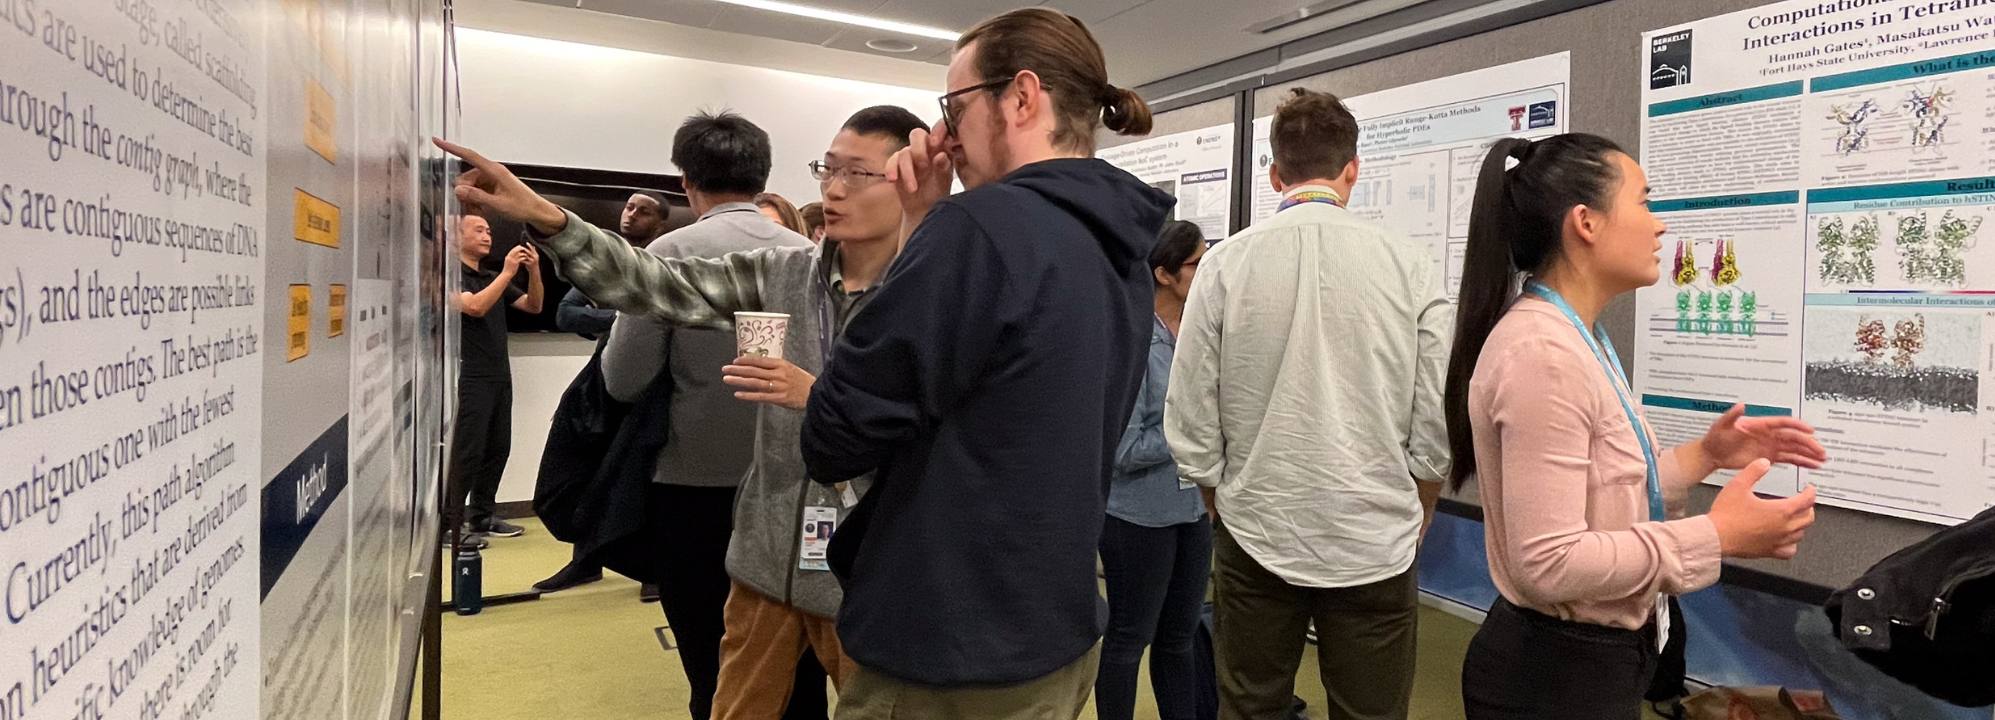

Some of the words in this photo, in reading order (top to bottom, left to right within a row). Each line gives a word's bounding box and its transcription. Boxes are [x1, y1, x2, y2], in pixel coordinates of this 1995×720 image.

[1653, 33, 1690, 46] BERKELEY
[1742, 19, 1865, 51] Interactions
[1871, 11, 1892, 27] in
[1899, 0, 1995, 21] Tetram
[1748, 0, 1893, 30] Computatio
[1768, 45, 1821, 65] Hannah
[1877, 22, 1961, 46] Masakatsu
[1965, 15, 1995, 29] Wa
[164, 16, 203, 71] called
[1653, 45, 1668, 54] LAB
[1787, 60, 1814, 74] Hays
[1816, 54, 1846, 69] State
[1848, 43, 1915, 63] University,
[1913, 59, 1950, 75] What
[1956, 58, 1971, 69] is
[43, 9, 76, 61] are
[82, 35, 127, 91] used
[132, 57, 148, 101] to
[152, 67, 217, 139] determine
[218, 108, 235, 148] the
[236, 117, 254, 158] best
[1700, 93, 1743, 107] Abstract
[1449, 105, 1482, 118] Methods
[82, 104, 111, 160] the
[116, 133, 163, 192] contig
[165, 151, 202, 200] graph,
[205, 160, 237, 202] where
[238, 172, 252, 207] the
[20, 188, 57, 232] are
[63, 192, 161, 258] contiguous
[164, 218, 223, 262] sequences
[225, 222, 237, 254] of
[236, 222, 259, 258] DNA
[1684, 196, 1752, 209] Introduction
[1853, 200, 1889, 210] Residue
[1890, 196, 1950, 208] Contribution
[1952, 196, 1963, 205] to
[39, 268, 80, 325] and
[87, 269, 115, 318] the
[120, 271, 165, 331] edges
[168, 283, 188, 313] are
[191, 273, 234, 325] possible
[234, 274, 256, 307] links
[1857, 295, 1923, 305] Intermolecular
[1926, 296, 1985, 307] Interactions
[31, 360, 88, 420] those
[94, 346, 157, 402] contigs.
[161, 338, 185, 380] The
[188, 334, 211, 372] best
[213, 328, 234, 378] path
[236, 327, 244, 359] is
[245, 324, 258, 355] the
[114, 428, 144, 469] one
[147, 402, 178, 454] with
[180, 395, 200, 435] the
[202, 384, 235, 426] fewest
[1691, 400, 1731, 412] Metho
[296, 450, 328, 526] Method
[6, 511, 117, 625] Currently,
[122, 488, 149, 540] this
[152, 464, 182, 534] path
[185, 437, 236, 501] algorithm
[31, 584, 127, 706] heuristics
[131, 549, 159, 606] that
[162, 536, 182, 577] are
[184, 490, 224, 555] derived
[226, 483, 248, 520] from
[72, 682, 103, 720] fic
[108, 597, 184, 707] knowledge
[187, 566, 200, 612] of
[140, 673, 173, 720] there
[176, 652, 185, 689] is
[188, 618, 216, 674] room
[218, 597, 232, 634] for
[180, 658, 221, 720] hrough
[223, 641, 239, 678] the
